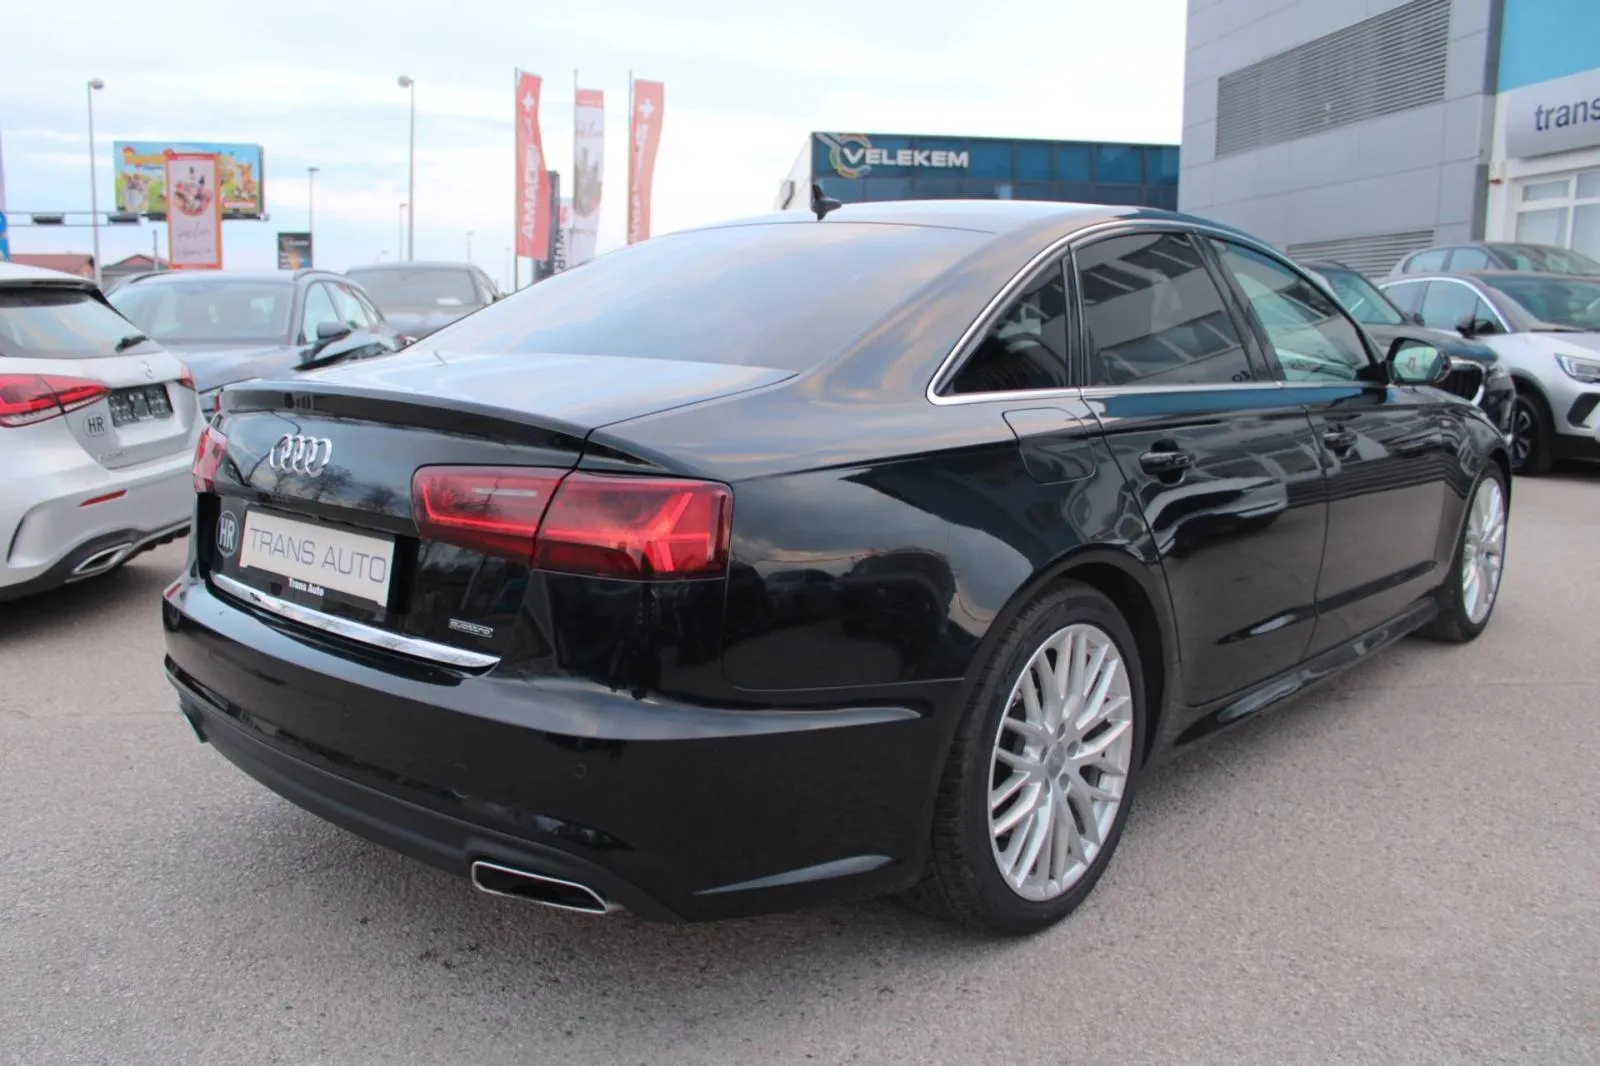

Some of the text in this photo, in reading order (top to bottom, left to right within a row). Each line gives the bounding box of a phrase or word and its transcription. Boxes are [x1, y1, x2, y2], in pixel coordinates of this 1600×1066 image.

[843, 148, 969, 168] VELEKEM
[87, 416, 105, 433] HR
[218, 518, 235, 549] HR
[250, 527, 387, 583] TRANS AUTO
[288, 577, 325, 597] Trans Auto
